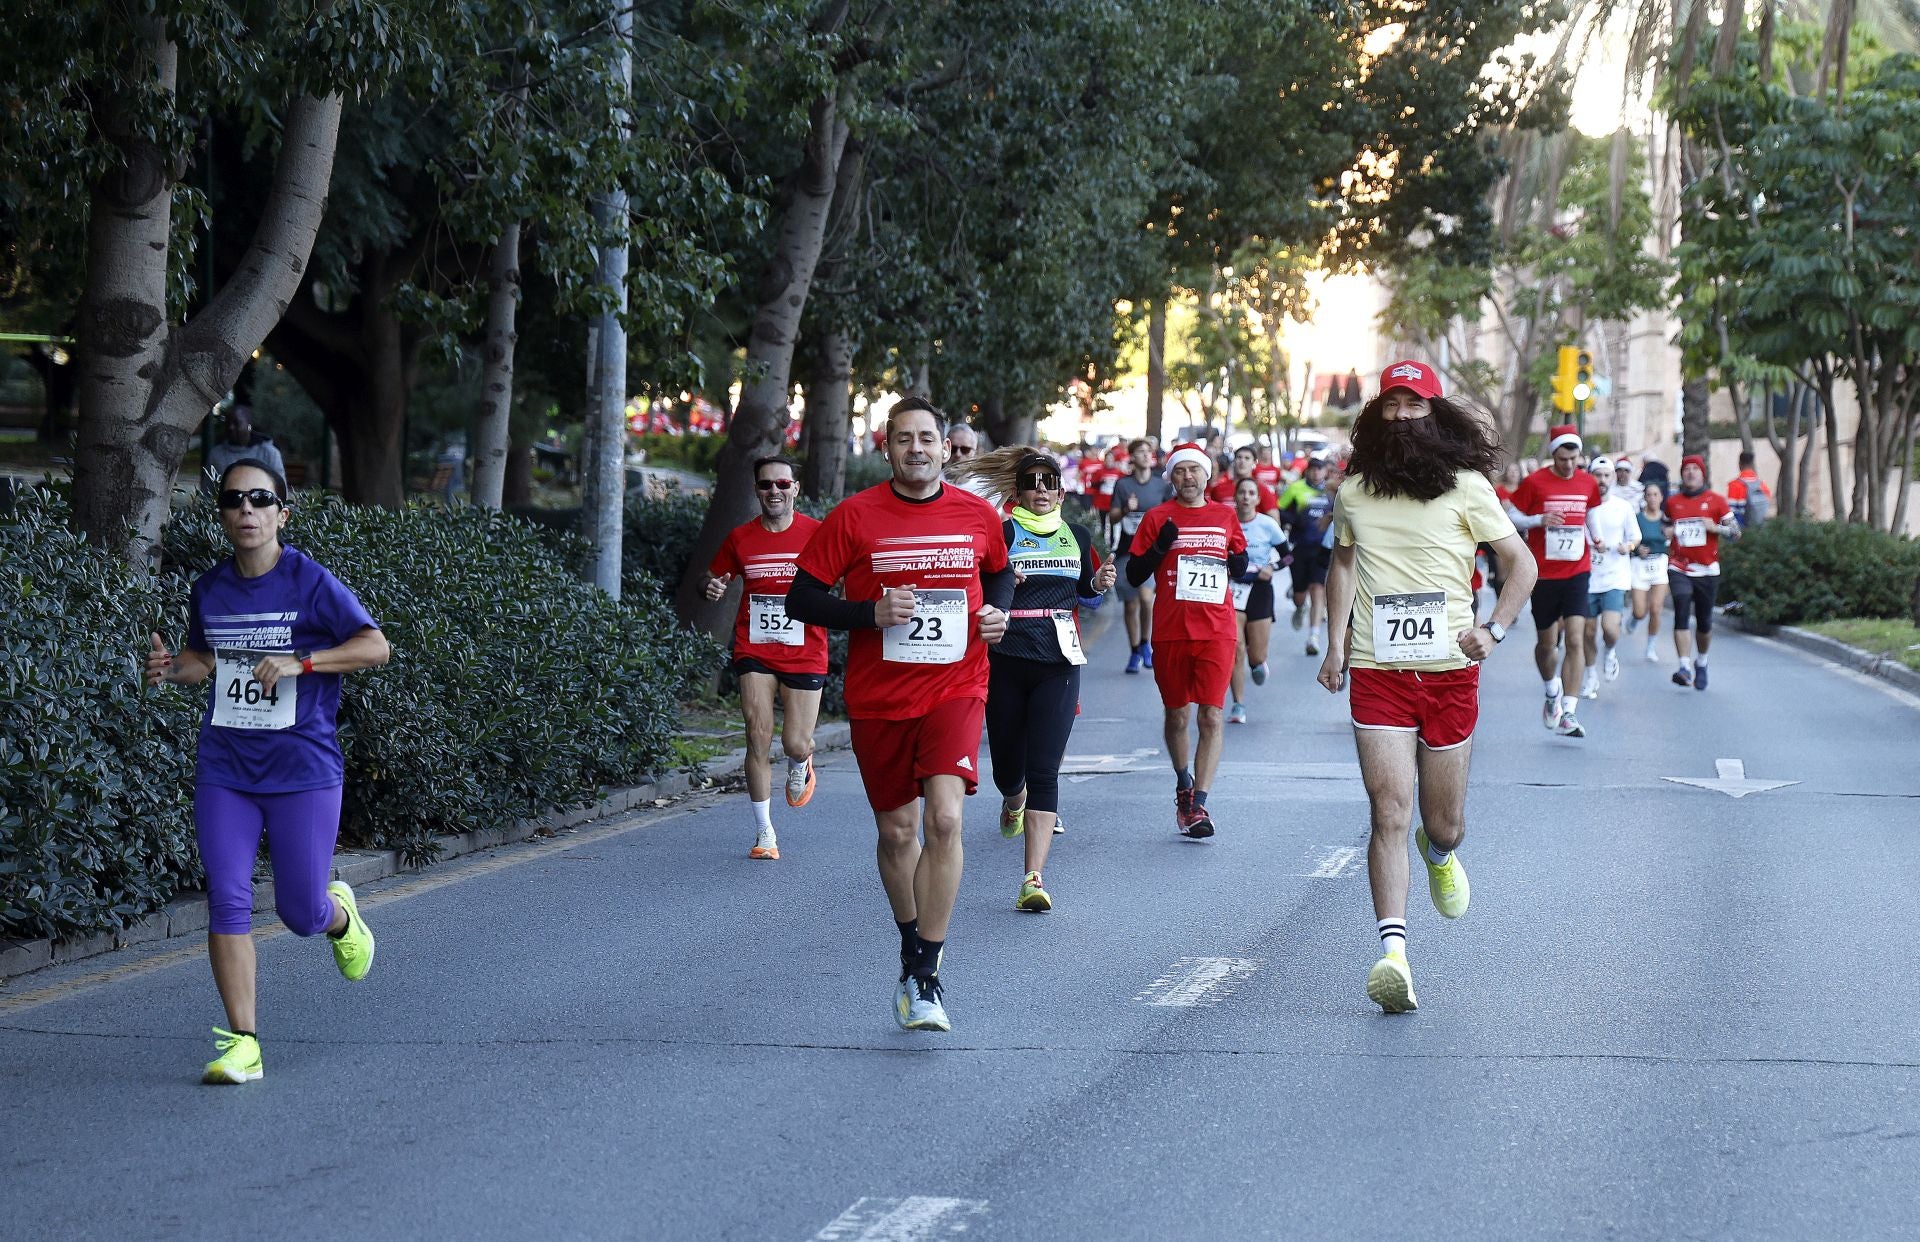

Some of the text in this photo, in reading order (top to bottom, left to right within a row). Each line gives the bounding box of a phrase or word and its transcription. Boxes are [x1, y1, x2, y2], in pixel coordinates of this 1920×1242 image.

[1558, 539, 1573, 550] 77
[935, 548, 974, 556] CARRERA
[900, 561, 974, 571] PALMA PALMILLA
[1188, 571, 1218, 588] 711
[282, 611, 298, 621] XIII
[760, 613, 793, 630] 552
[250, 626, 292, 636] CARRERA
[908, 616, 943, 641] 23
[1387, 617, 1434, 641] 704
[254, 632, 292, 640] SILVESTRE
[219, 638, 292, 648] PALMA PALMILLA
[227, 677, 279, 706] 464
